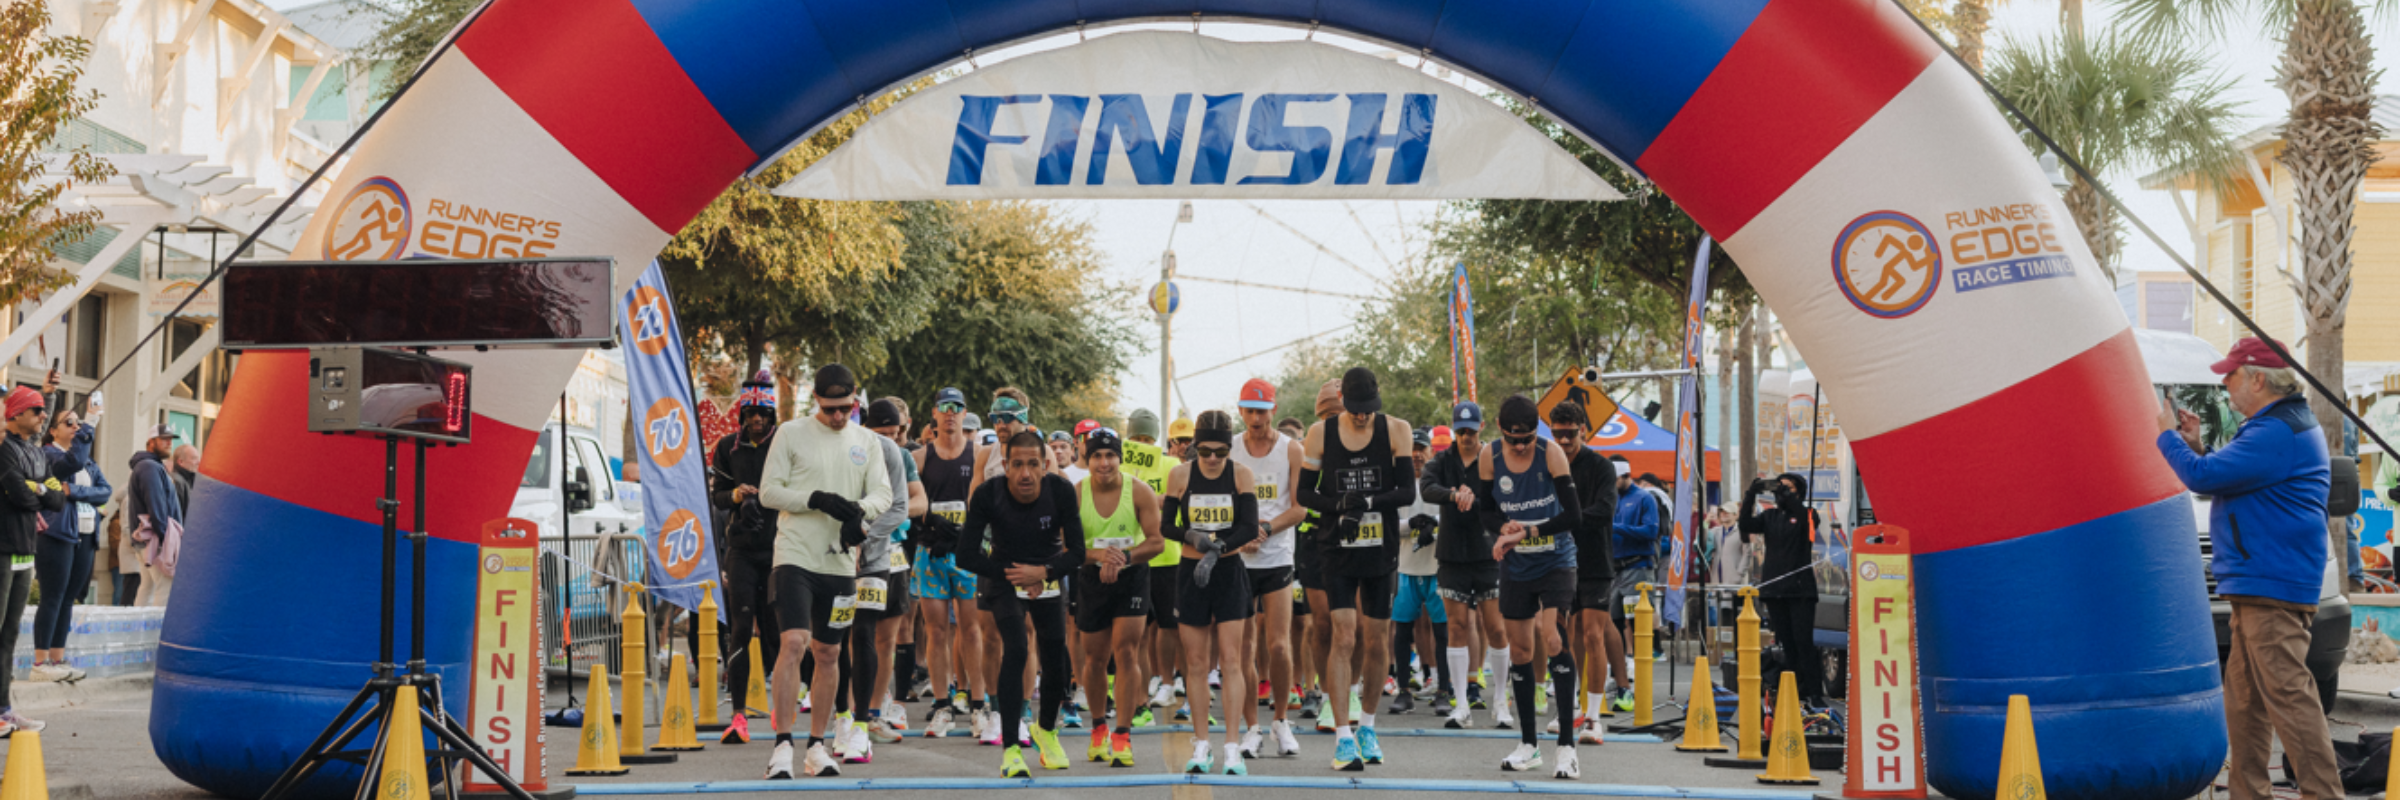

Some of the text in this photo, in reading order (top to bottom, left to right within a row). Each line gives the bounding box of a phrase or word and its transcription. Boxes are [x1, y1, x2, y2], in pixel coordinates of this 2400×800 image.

[946, 92, 1438, 186] FINISH
[428, 198, 562, 239] RUNNER'S
[1945, 203, 2052, 230] RUNNER'S
[1950, 222, 2065, 265] EDGE
[1957, 257, 2076, 288] RACE TIMING
[650, 407, 684, 456] 76
[1124, 449, 1155, 468] 3:30
[1193, 507, 1229, 523] 2910
[664, 517, 699, 568] 76
[487, 589, 517, 776] FINISH
[1873, 596, 1902, 784] FINISH
